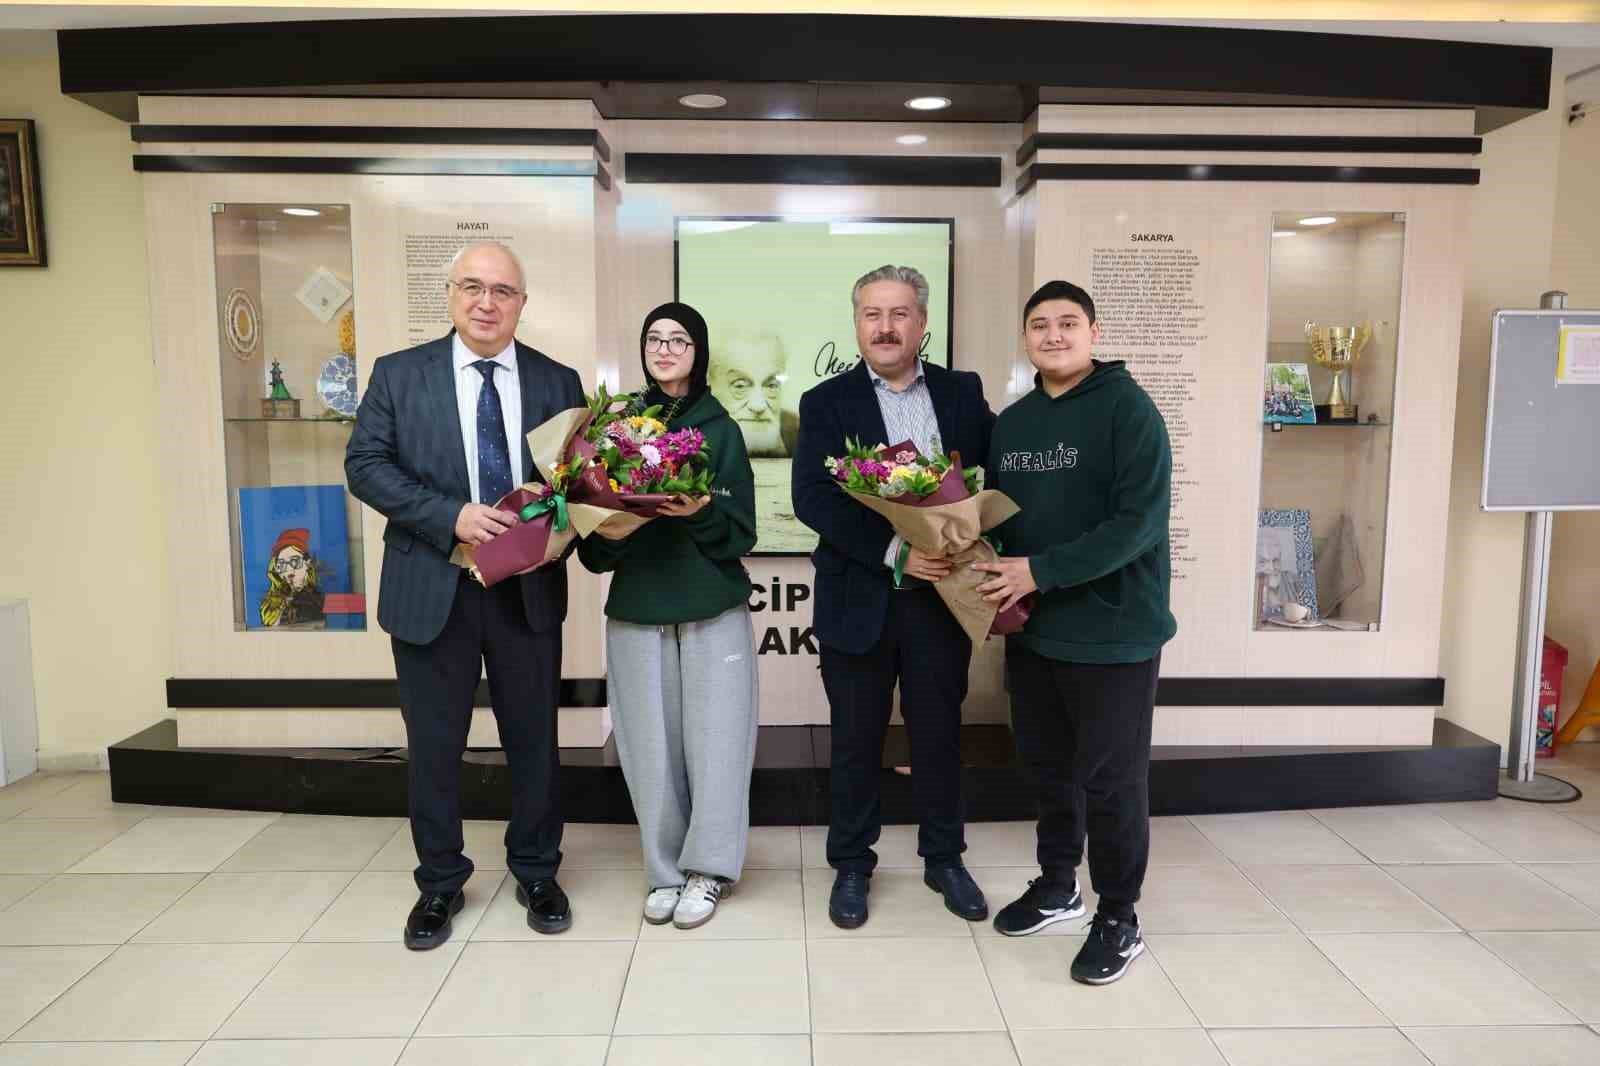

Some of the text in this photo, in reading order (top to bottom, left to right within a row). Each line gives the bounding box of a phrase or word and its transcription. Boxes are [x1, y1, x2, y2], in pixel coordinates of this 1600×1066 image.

[456, 222, 489, 231] HAYATI
[1130, 233, 1174, 242] SAKARYA
[748, 576, 811, 613] CİP
[758, 626, 820, 655] AK
